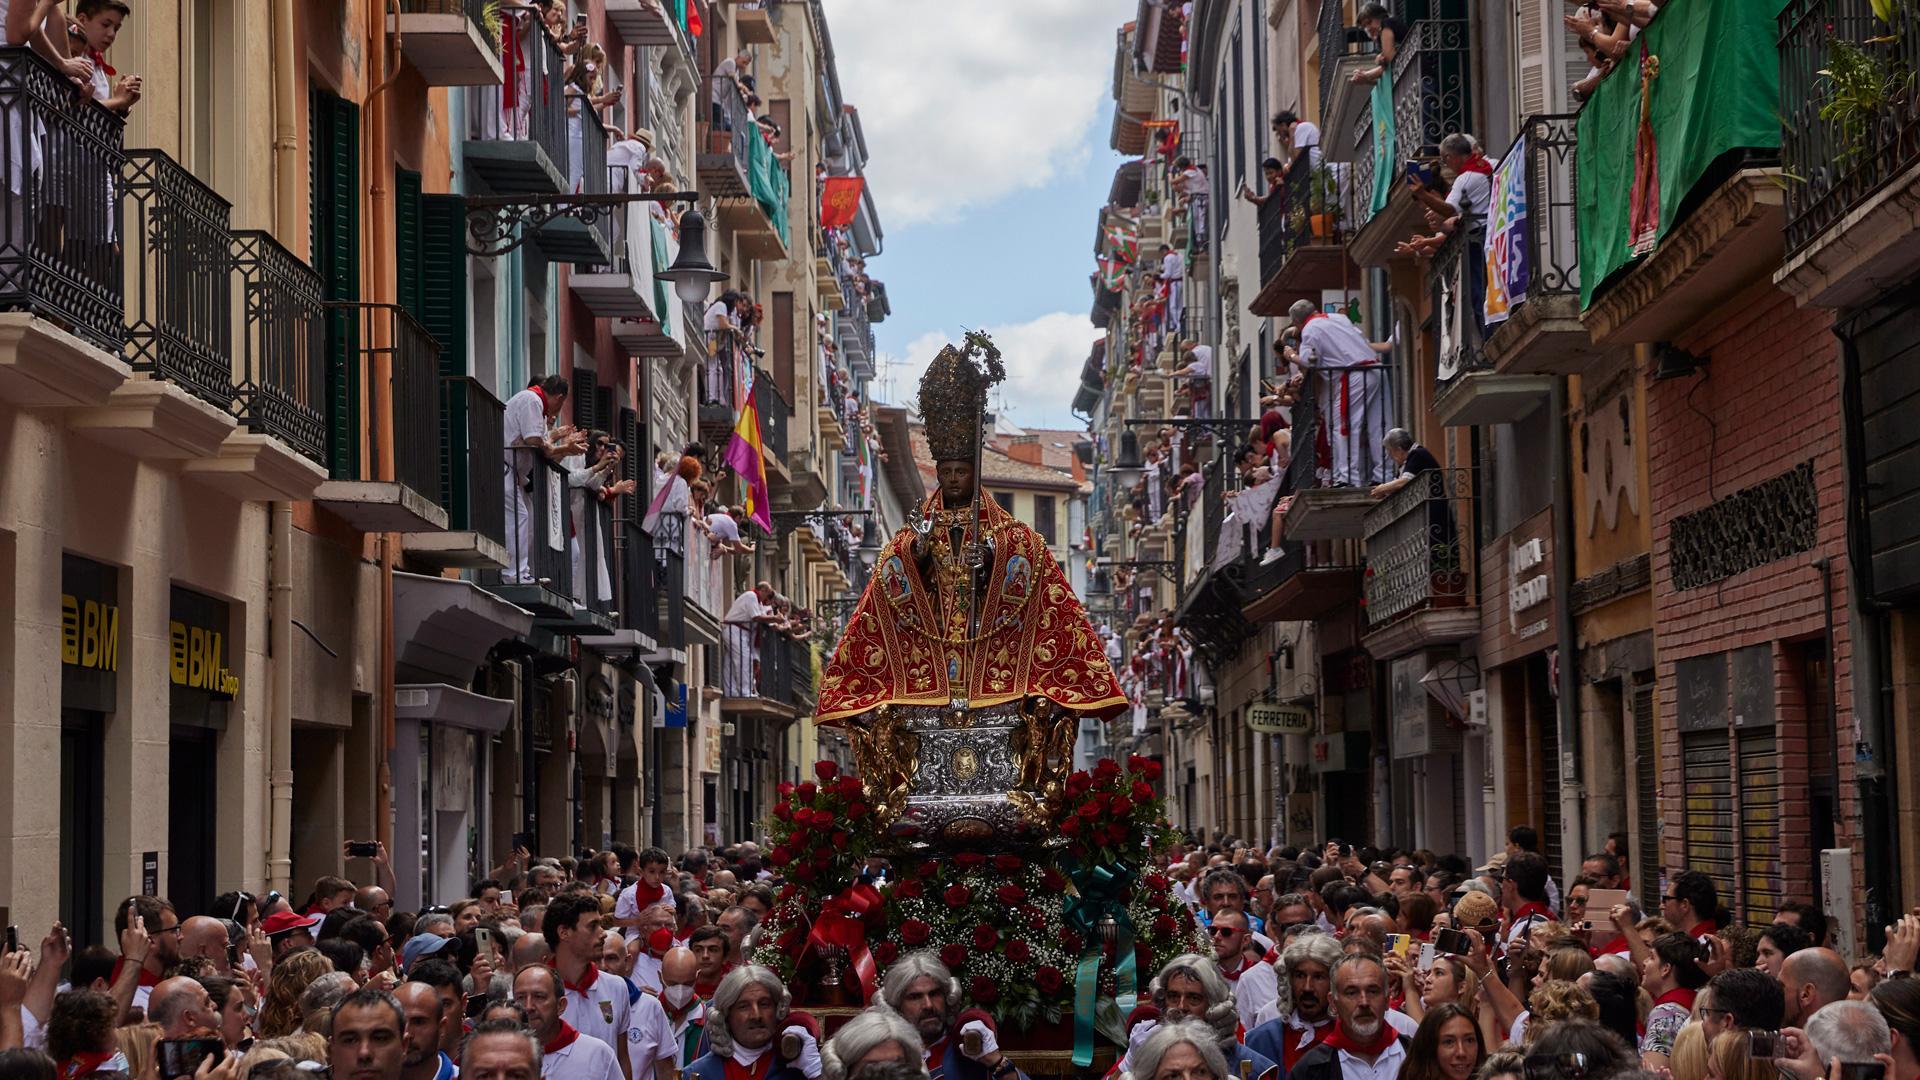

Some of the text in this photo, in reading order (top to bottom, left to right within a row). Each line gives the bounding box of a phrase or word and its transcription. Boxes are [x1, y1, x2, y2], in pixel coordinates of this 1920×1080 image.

[82, 600, 119, 671] BM
[189, 626, 221, 691] BM
[1252, 710, 1307, 728] FERRETERIA
